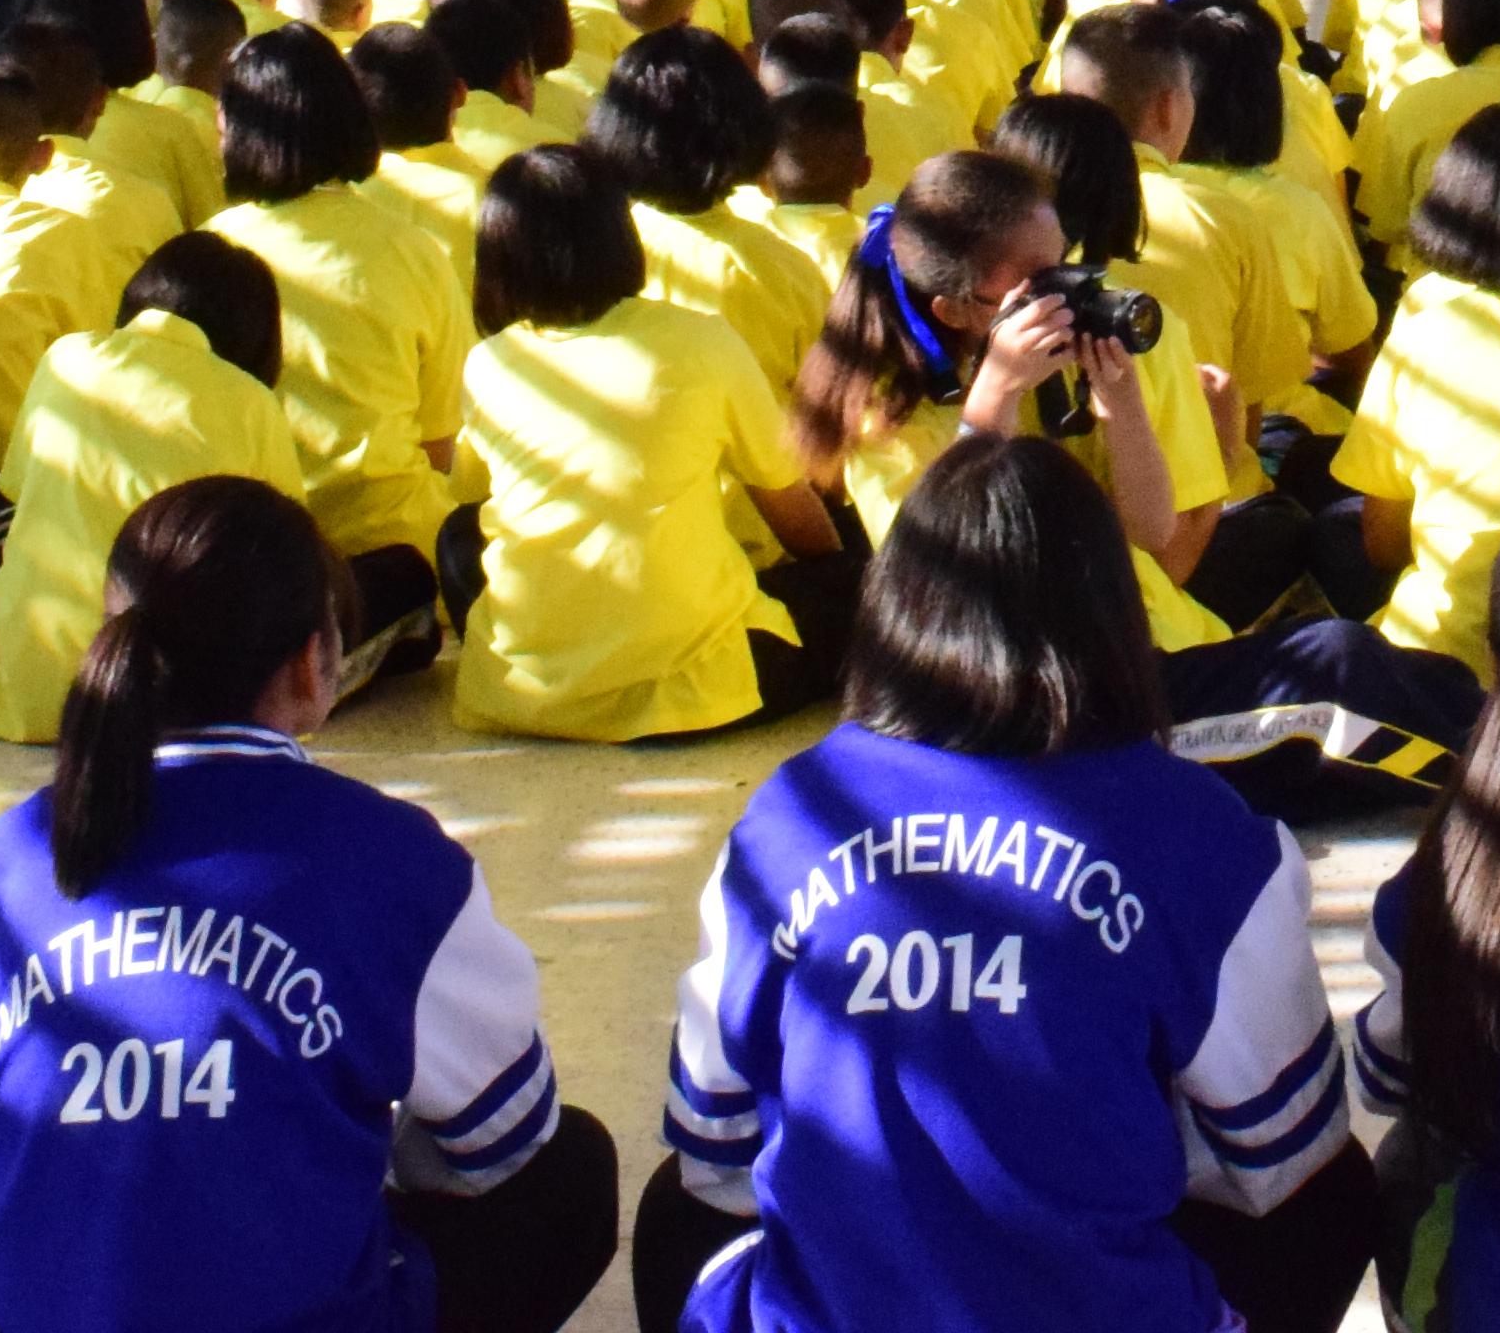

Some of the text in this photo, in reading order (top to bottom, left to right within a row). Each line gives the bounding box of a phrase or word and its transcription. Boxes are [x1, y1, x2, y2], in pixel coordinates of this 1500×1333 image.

[771, 812, 1145, 962] MATHEMATICS
[845, 929, 1028, 1016] 2014
[59, 1037, 236, 1125] 2014
